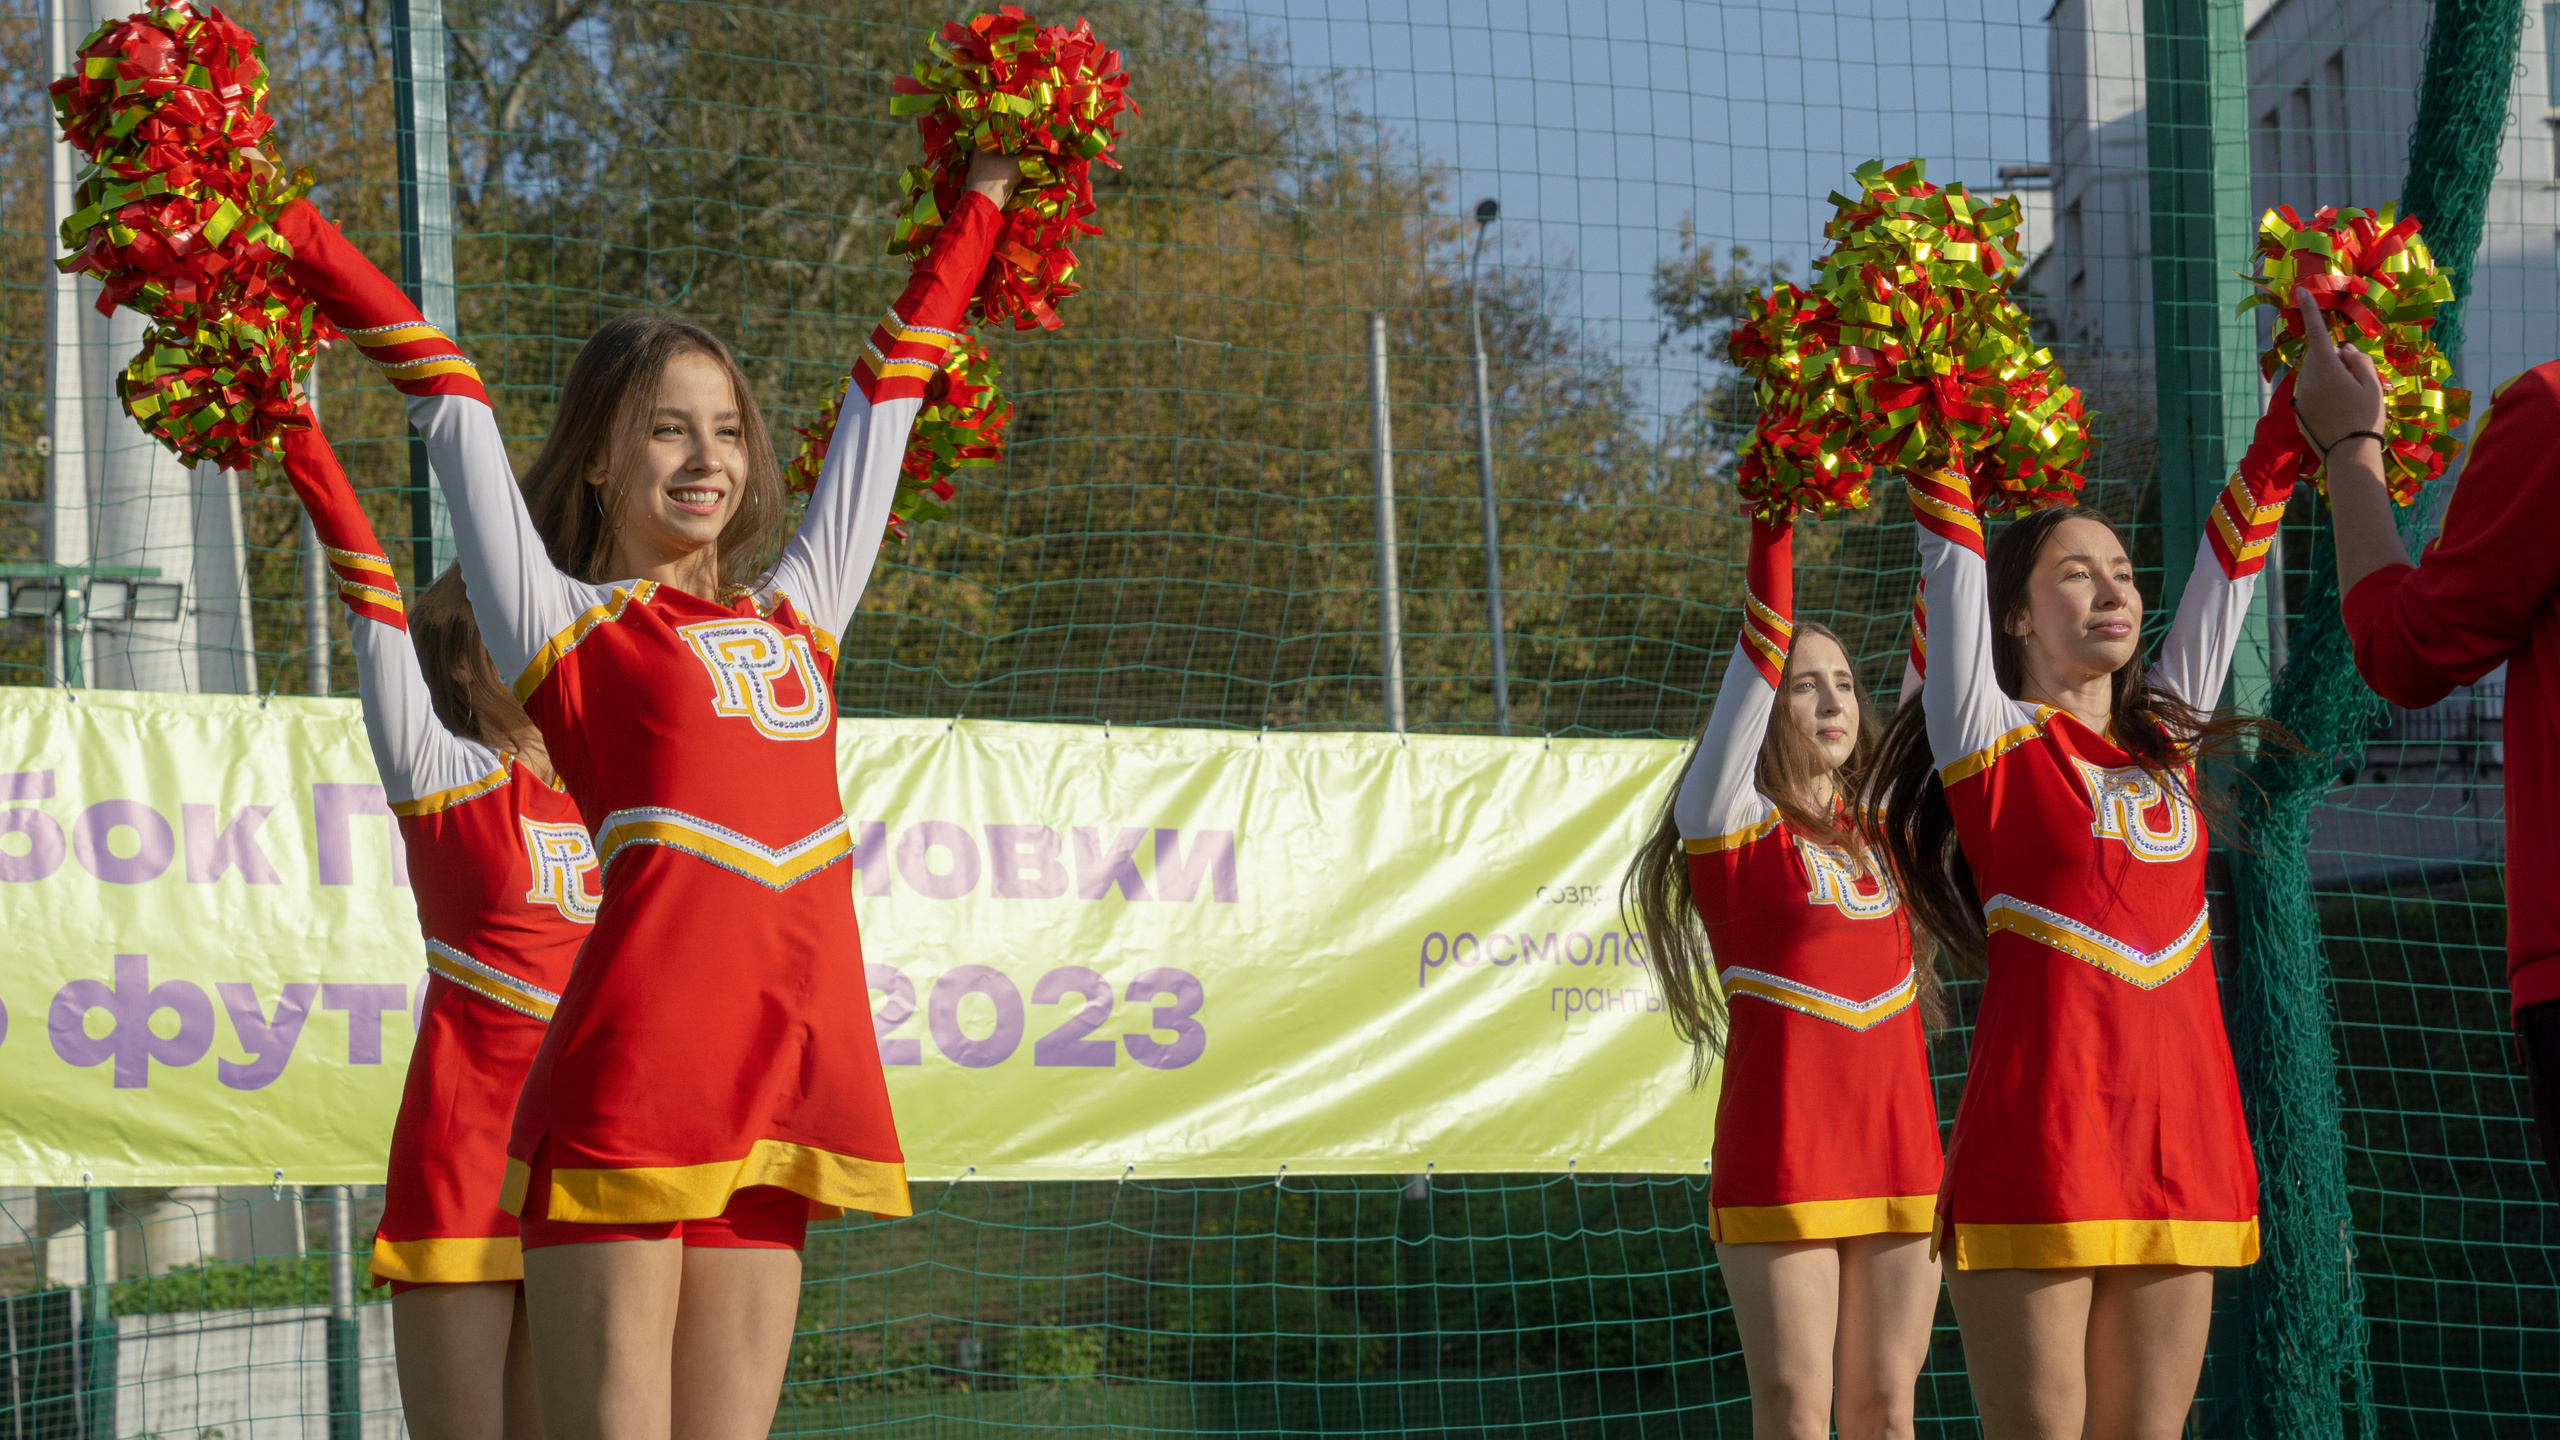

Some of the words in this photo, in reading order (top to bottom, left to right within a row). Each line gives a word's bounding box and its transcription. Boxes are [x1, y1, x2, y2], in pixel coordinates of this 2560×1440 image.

[1536, 885, 1621, 907] созда
[47, 954, 430, 1090] фут
[863, 963, 1207, 1070] 2023
